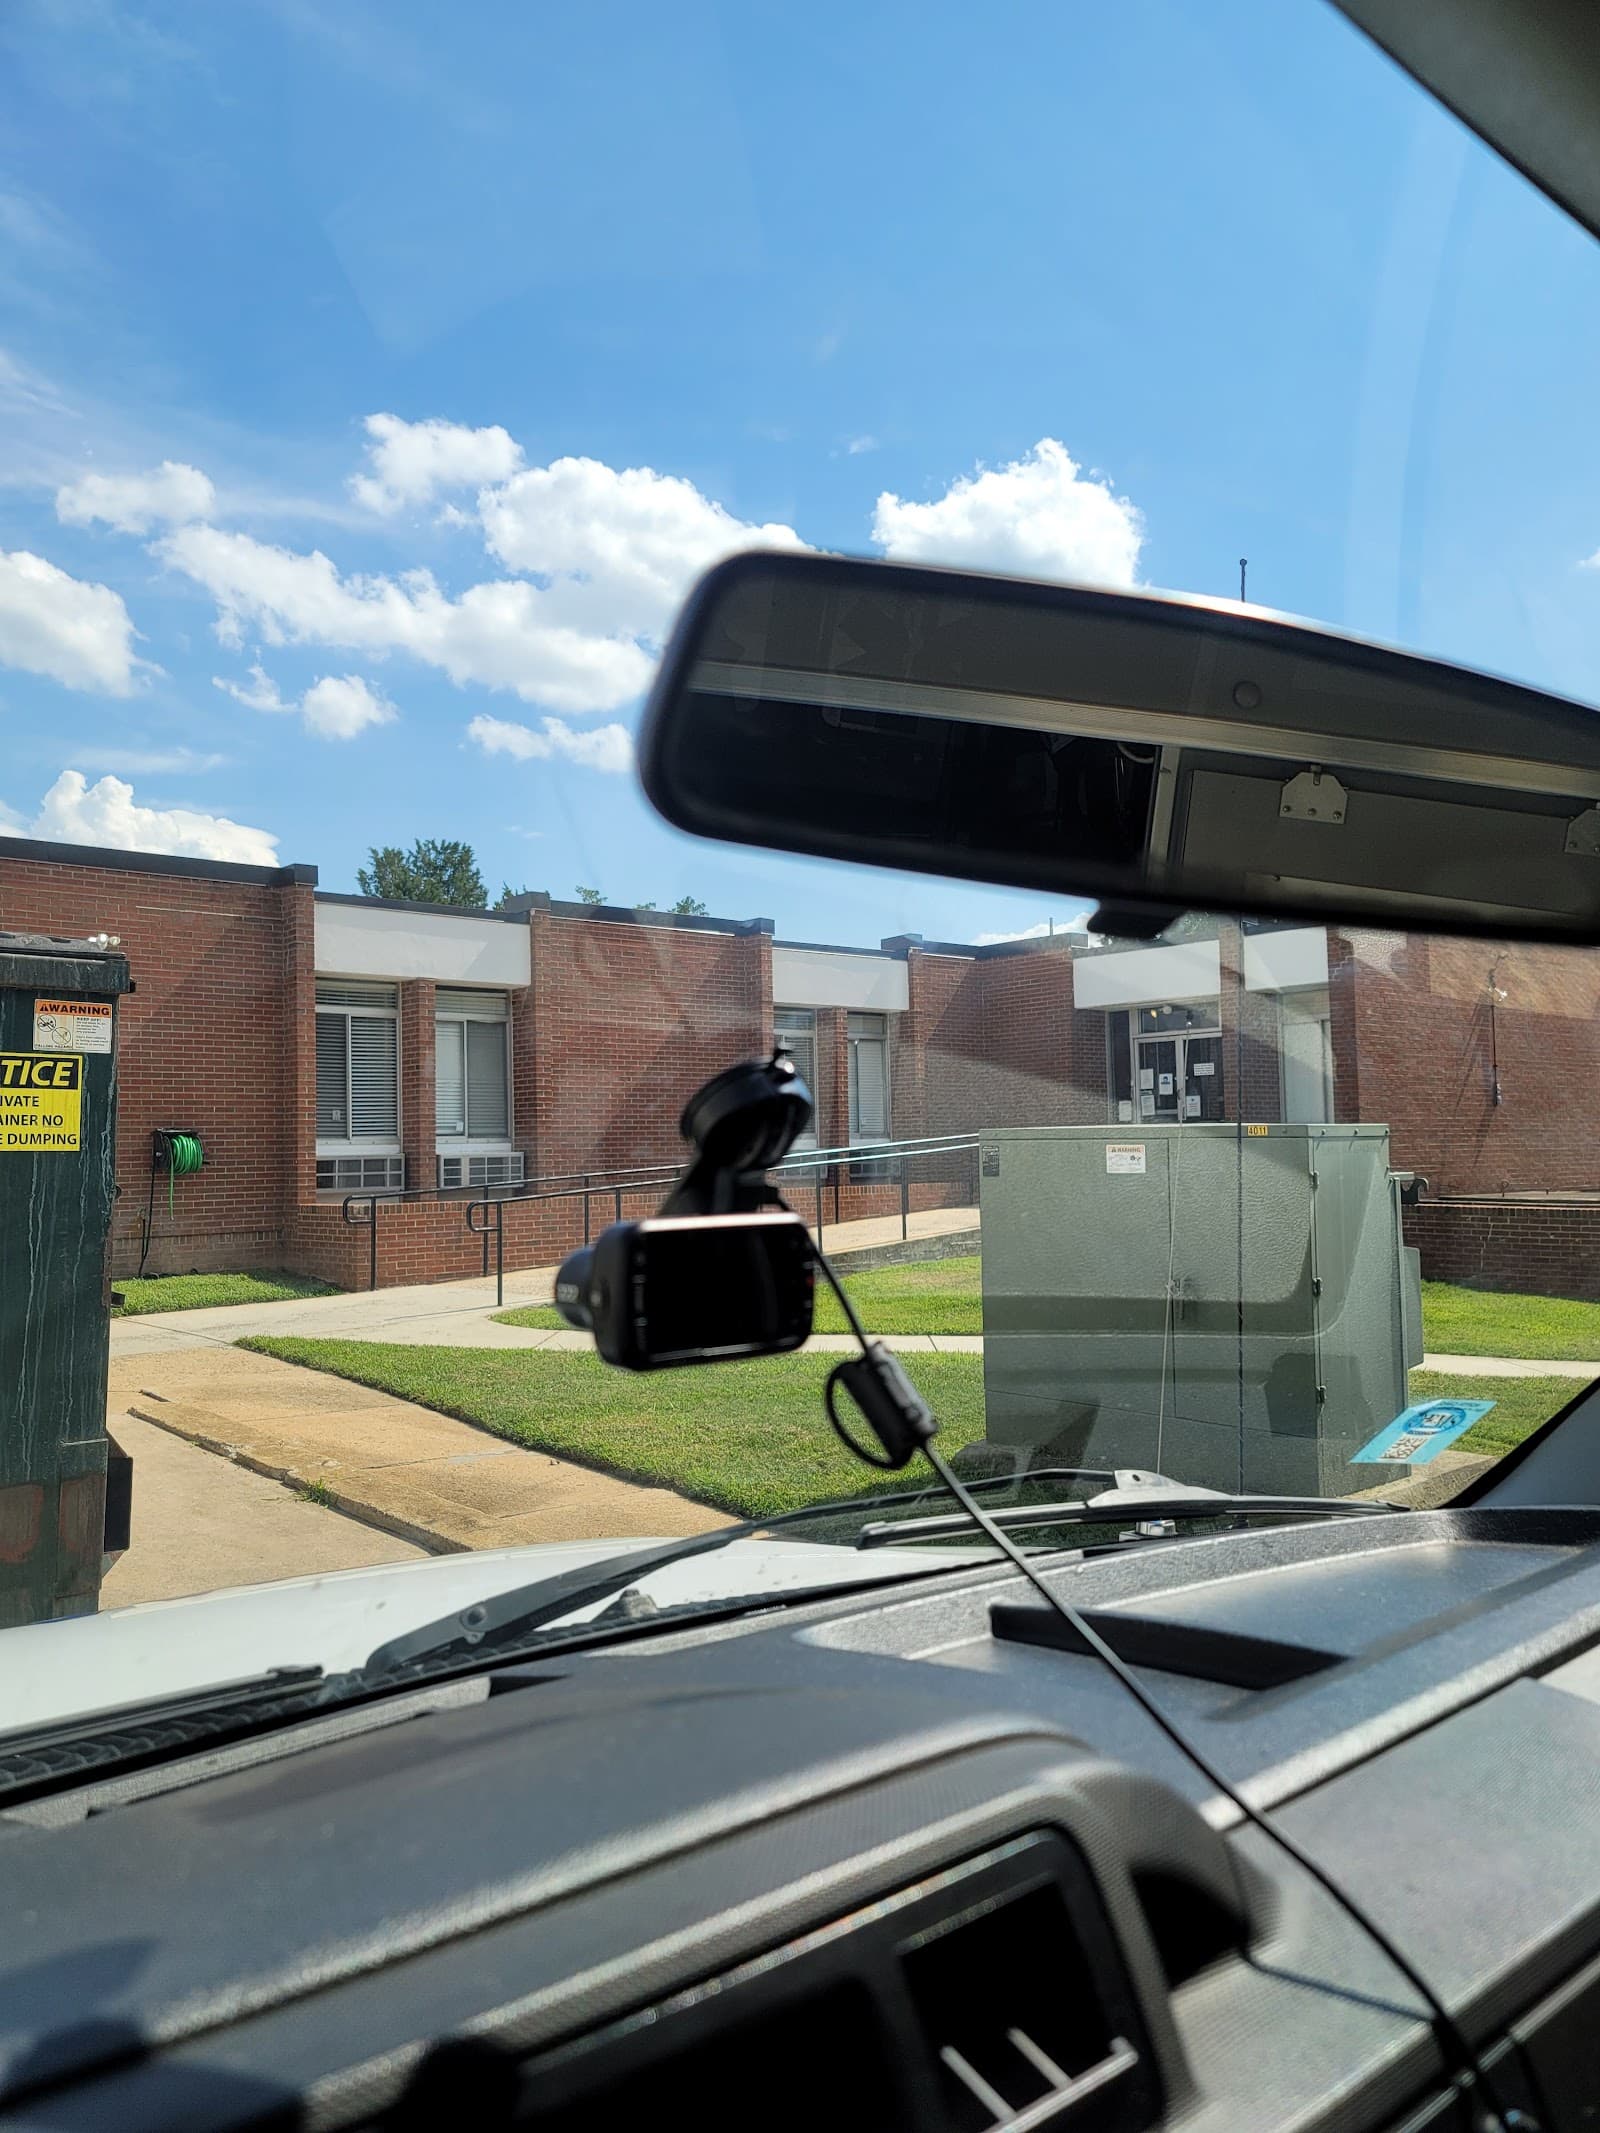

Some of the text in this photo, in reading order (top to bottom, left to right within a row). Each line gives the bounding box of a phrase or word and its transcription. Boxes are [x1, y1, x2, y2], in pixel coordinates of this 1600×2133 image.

[49, 1004, 110, 1016] WARNING
[1, 1060, 73, 1087] TICE
[42, 1115, 64, 1126] NO
[7, 1133, 77, 1145] DUMPING
